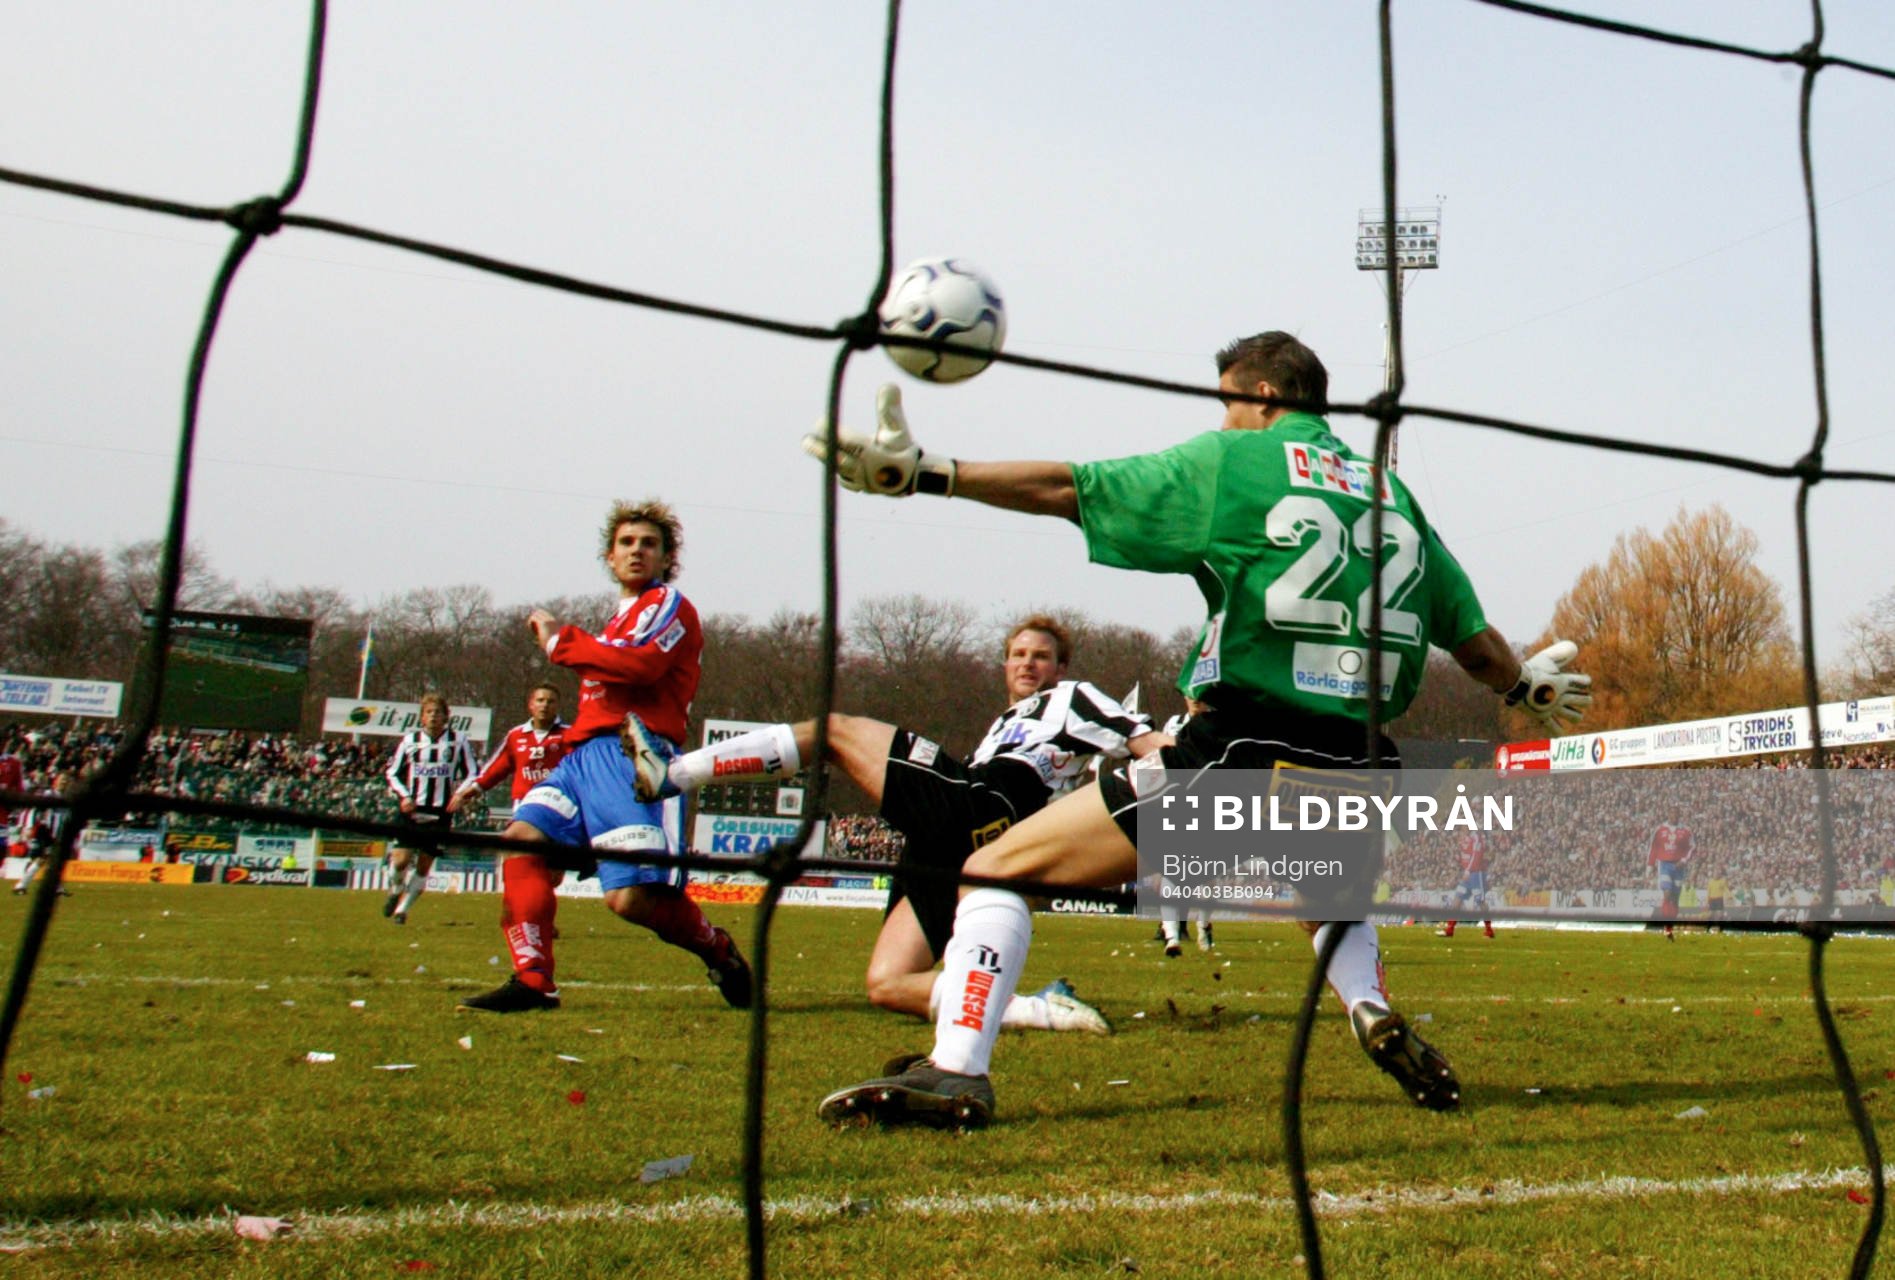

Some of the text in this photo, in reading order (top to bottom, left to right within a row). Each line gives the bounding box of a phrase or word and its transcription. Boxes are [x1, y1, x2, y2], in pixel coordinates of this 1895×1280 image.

[1265, 495, 1425, 646] 22
[1296, 671, 1391, 695] Rörläggan
[1744, 731, 1796, 751] TRYCKERI
[528, 746, 545, 759] 23
[522, 766, 551, 781] fina
[713, 755, 764, 777] besam
[712, 816, 799, 836] ÖRESUND
[248, 869, 309, 884] sydkraf
[952, 970, 995, 1032] besam
